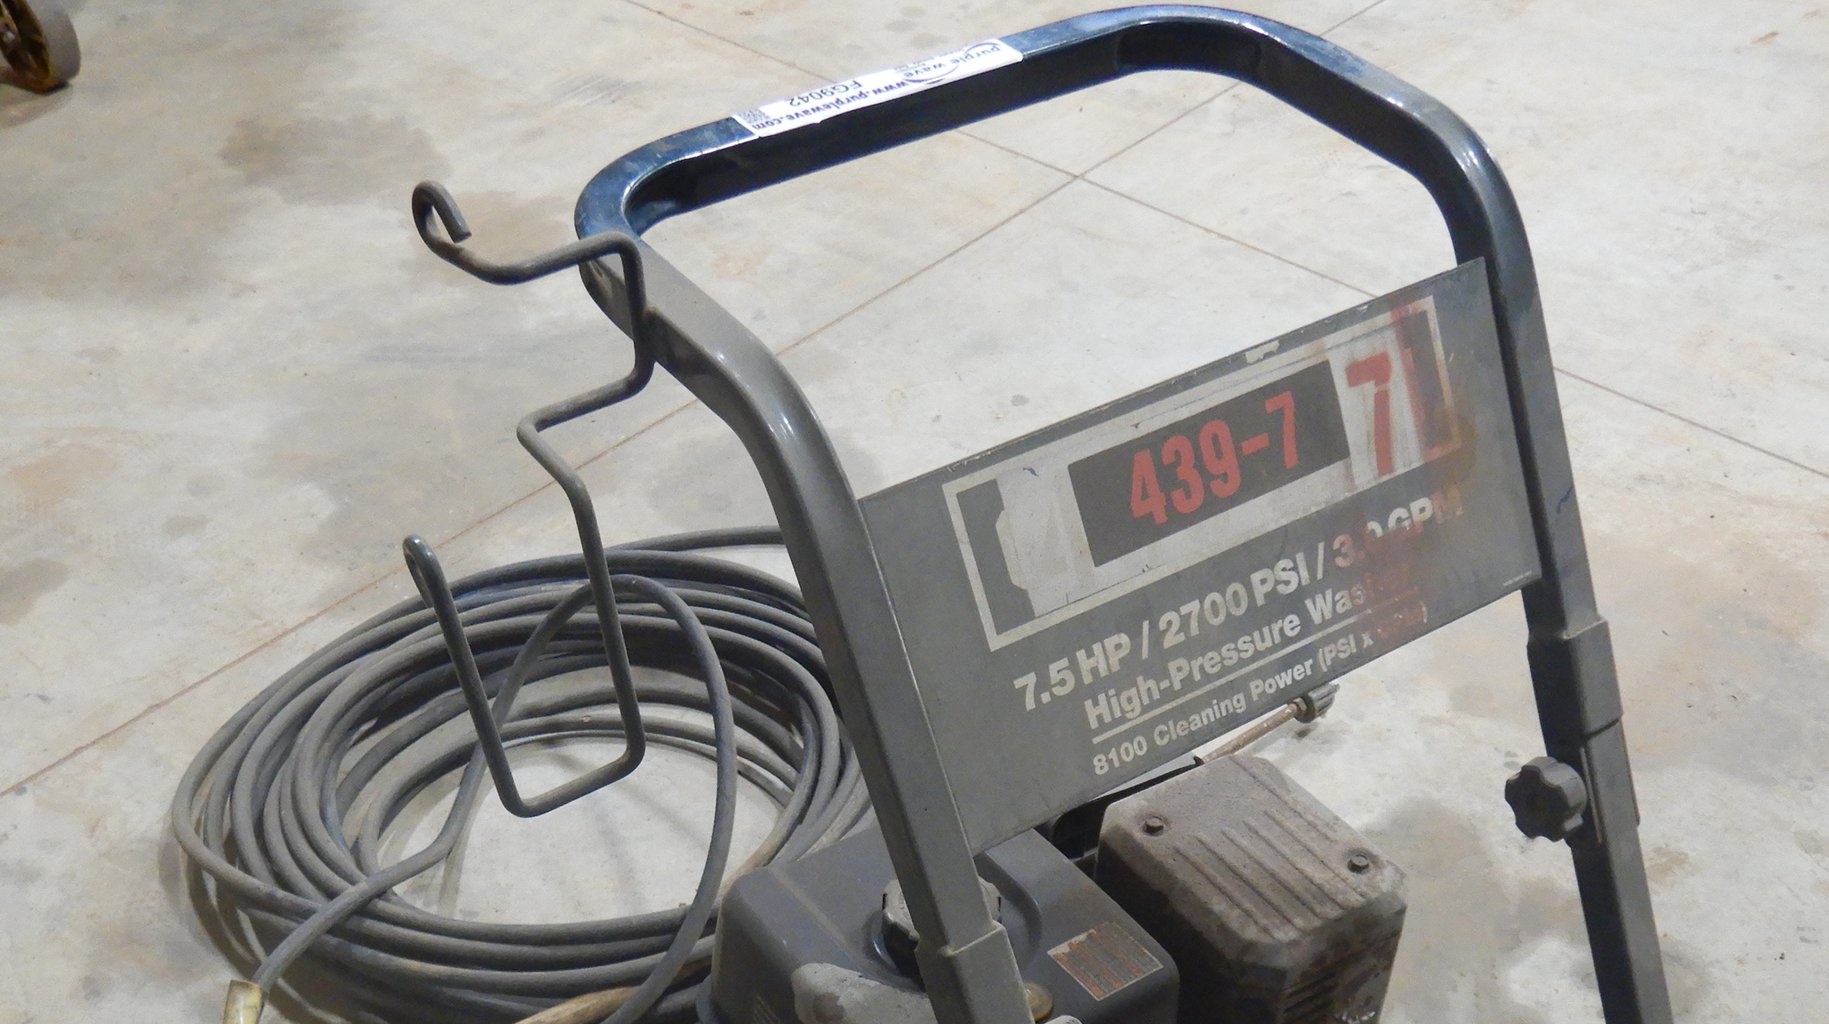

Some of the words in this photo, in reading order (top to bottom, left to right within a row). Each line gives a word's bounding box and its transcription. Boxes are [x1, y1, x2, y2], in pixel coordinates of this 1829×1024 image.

[788, 79, 863, 107] FG9042
[903, 61, 947, 78] wave
[951, 44, 1001, 65] purple
[752, 80, 910, 131] www.purplewave.com
[1130, 390, 1299, 525] 439-7
[1013, 657, 1076, 712] 7.5
[1076, 632, 1131, 685] HP
[1142, 619, 1150, 660] /
[1158, 582, 1248, 649] 2700
[1250, 551, 1310, 607] PSI
[1316, 541, 1325, 580] /
[1083, 613, 1301, 730] High-Pressure
[1093, 735, 1147, 775] 8100
[1153, 692, 1247, 746] Cleaning
[1249, 658, 1313, 701] Power
[1317, 633, 1357, 672] (PSI
[1362, 631, 1374, 649] x
